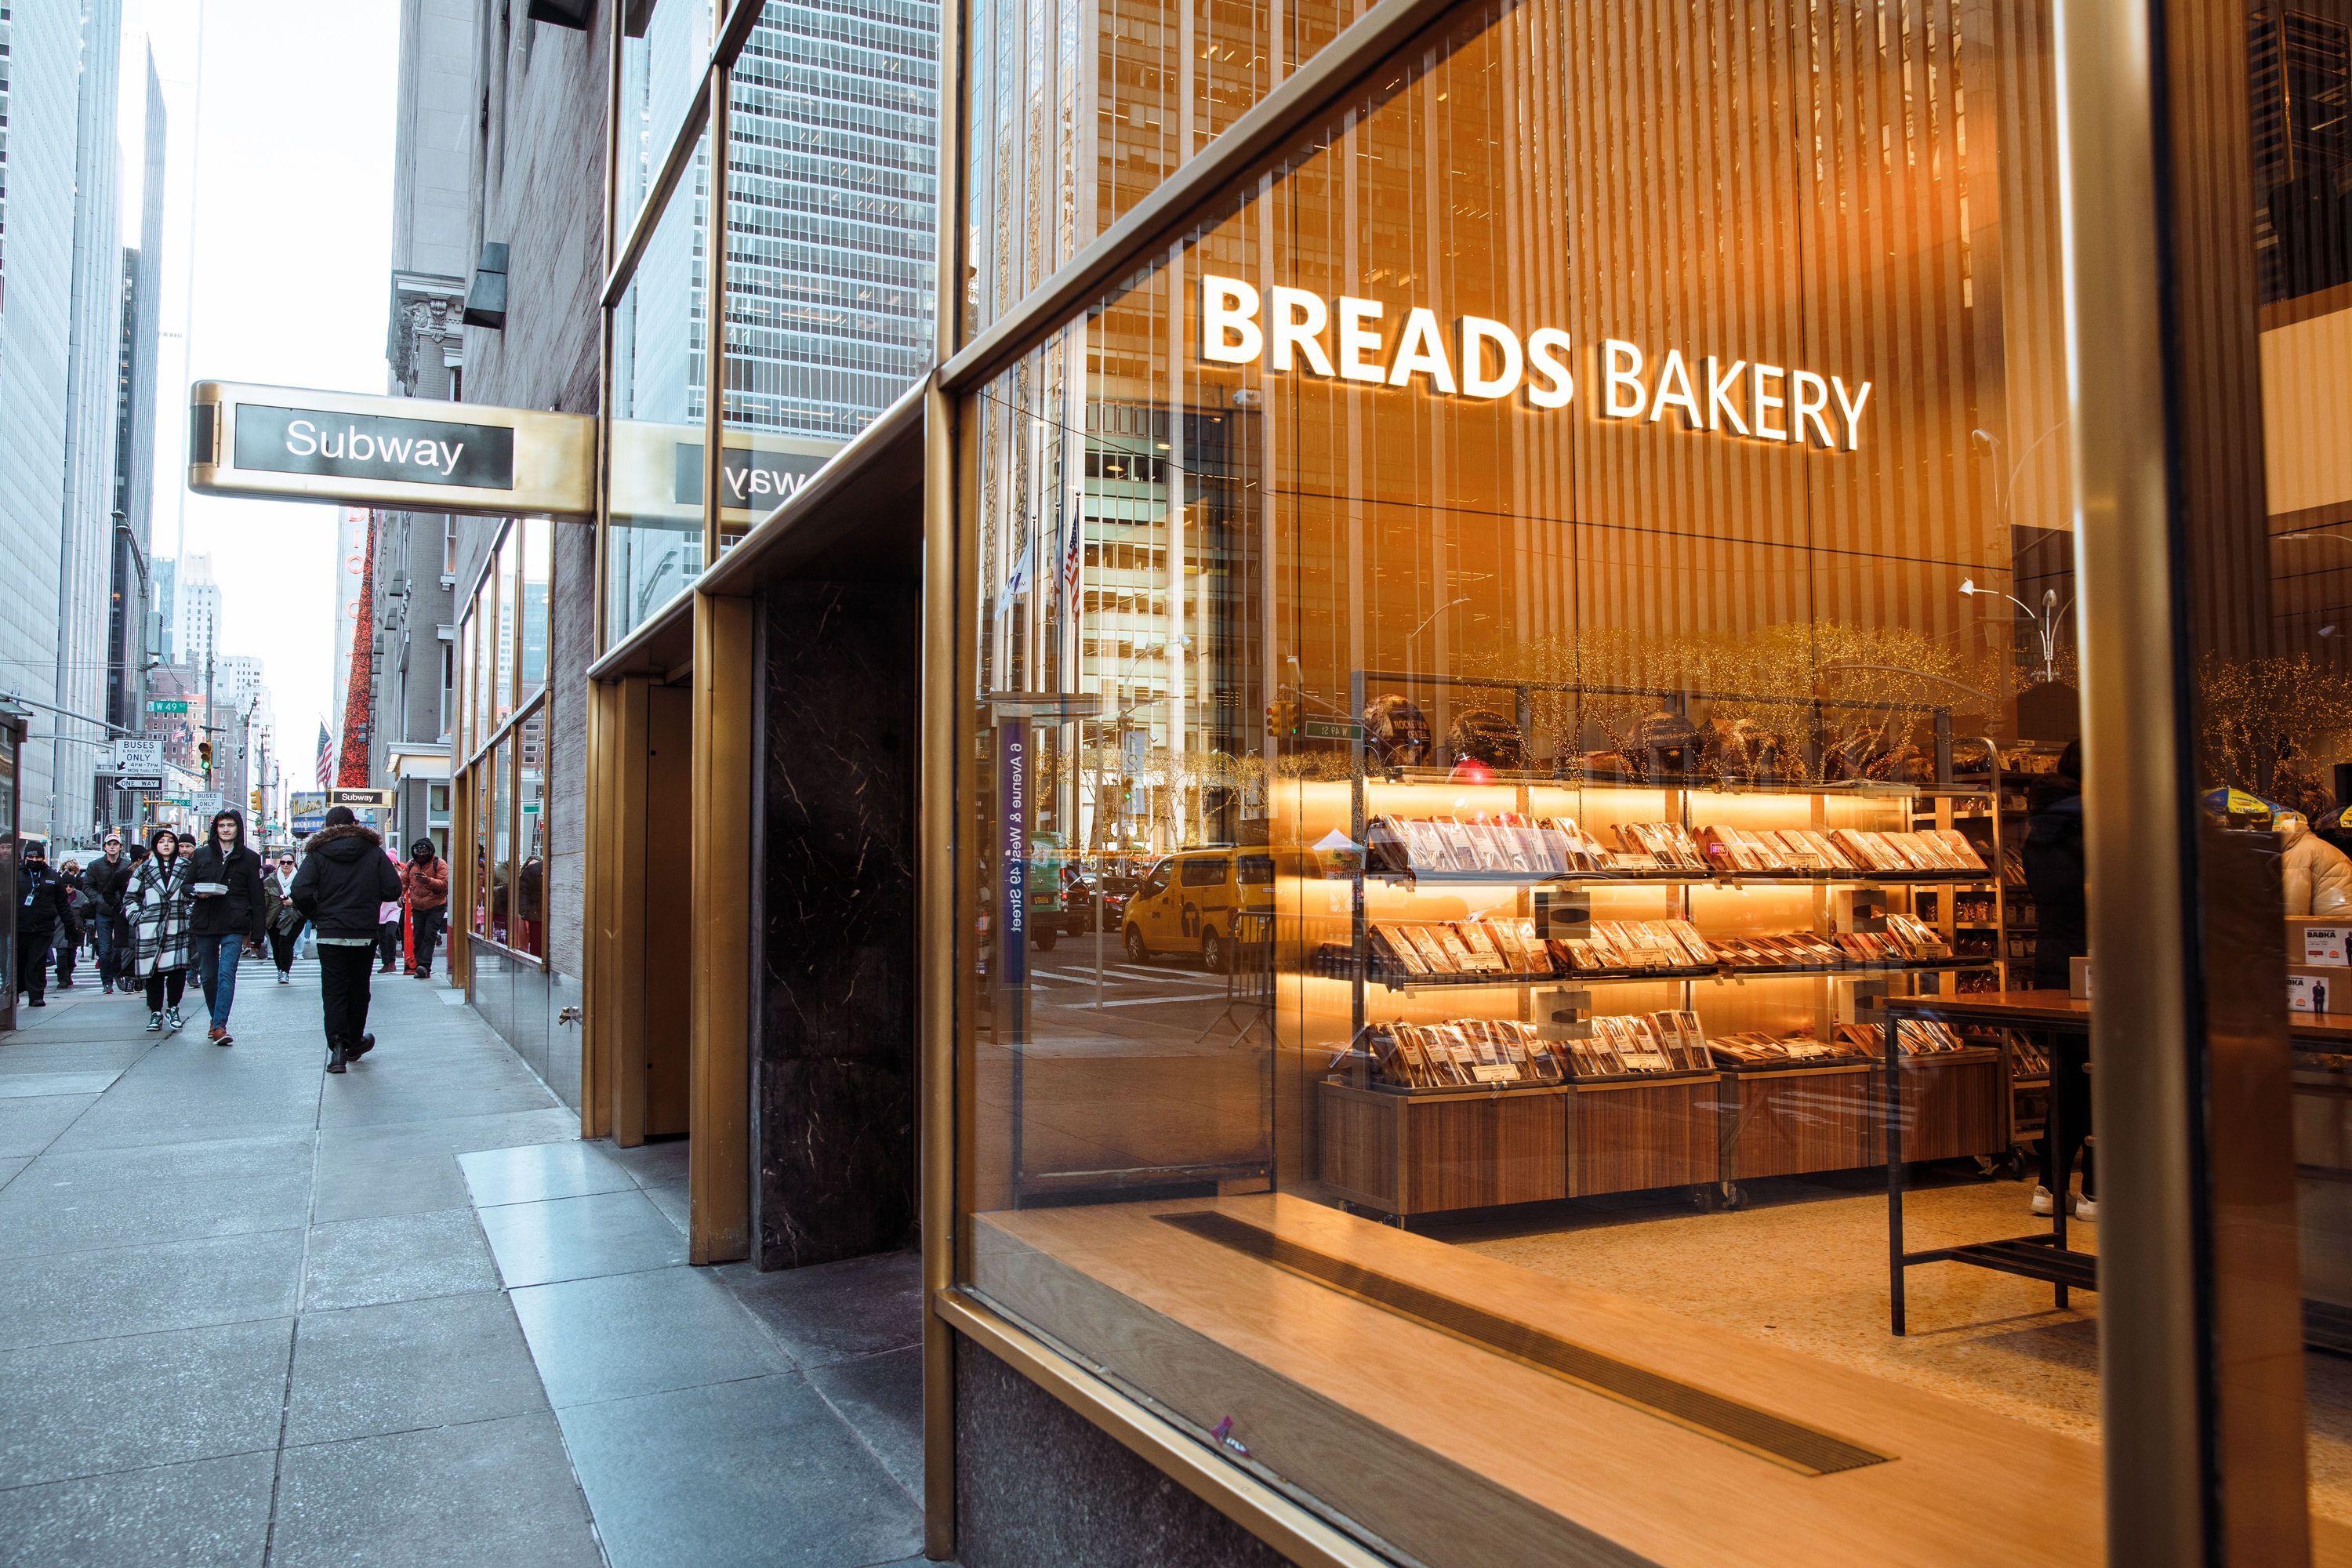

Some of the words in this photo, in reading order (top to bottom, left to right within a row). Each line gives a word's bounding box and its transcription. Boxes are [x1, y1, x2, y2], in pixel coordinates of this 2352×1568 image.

[1202, 273, 1574, 409] BREADS
[1604, 337, 1872, 452] BAKERY
[286, 419, 464, 477] Subway
[292, 799, 322, 816] Music
[341, 793, 374, 803] Subway
